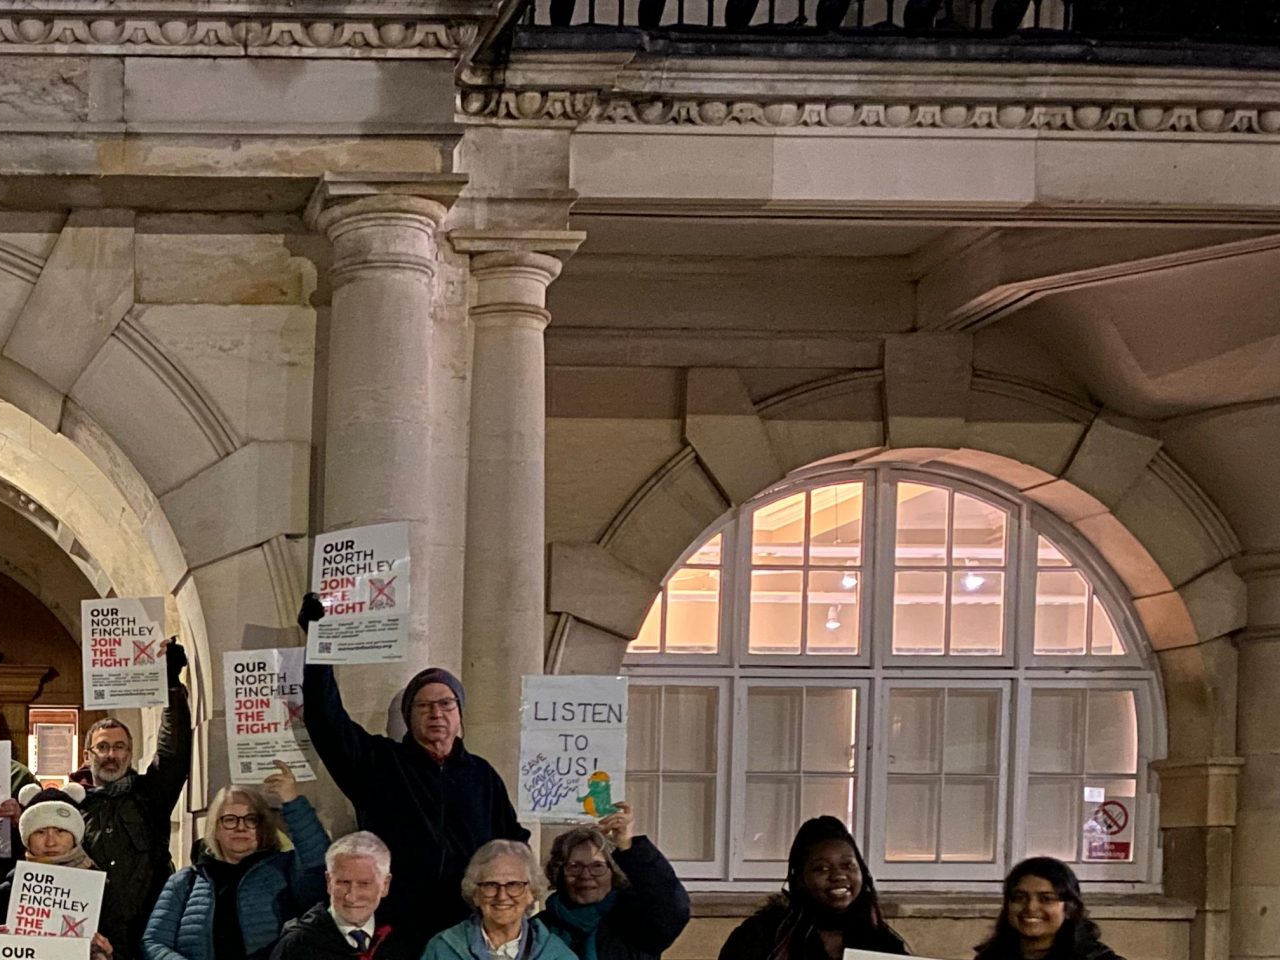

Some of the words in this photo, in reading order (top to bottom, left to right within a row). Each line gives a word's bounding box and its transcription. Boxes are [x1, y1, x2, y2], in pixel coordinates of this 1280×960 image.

[323, 540, 355, 554] OUR
[322, 549, 374, 566] NORTH
[321, 560, 396, 579] FINCHLEY
[320, 577, 356, 592] JOIN
[91, 608, 119, 617] OUR
[91, 617, 136, 627] NORTH
[91, 626, 154, 637] FINCHLEY
[91, 638, 122, 647] JOIN
[92, 648, 117, 657] THE
[92, 658, 130, 668] FIGHT
[234, 662, 267, 673] OUR
[235, 673, 286, 686] NORTH
[235, 699, 270, 711] JOIN
[235, 711, 265, 722] THE
[534, 701, 622, 723] LISTEN
[236, 722, 280, 735] FIGHT
[558, 734, 588, 752] TO
[23, 872, 55, 885] OUR
[21, 883, 71, 899] NORTH
[19, 893, 89, 912] FINCHLEY
[16, 905, 51, 919] JOIN
[16, 916, 44, 930] THE
[2, 947, 35, 959] OUR
